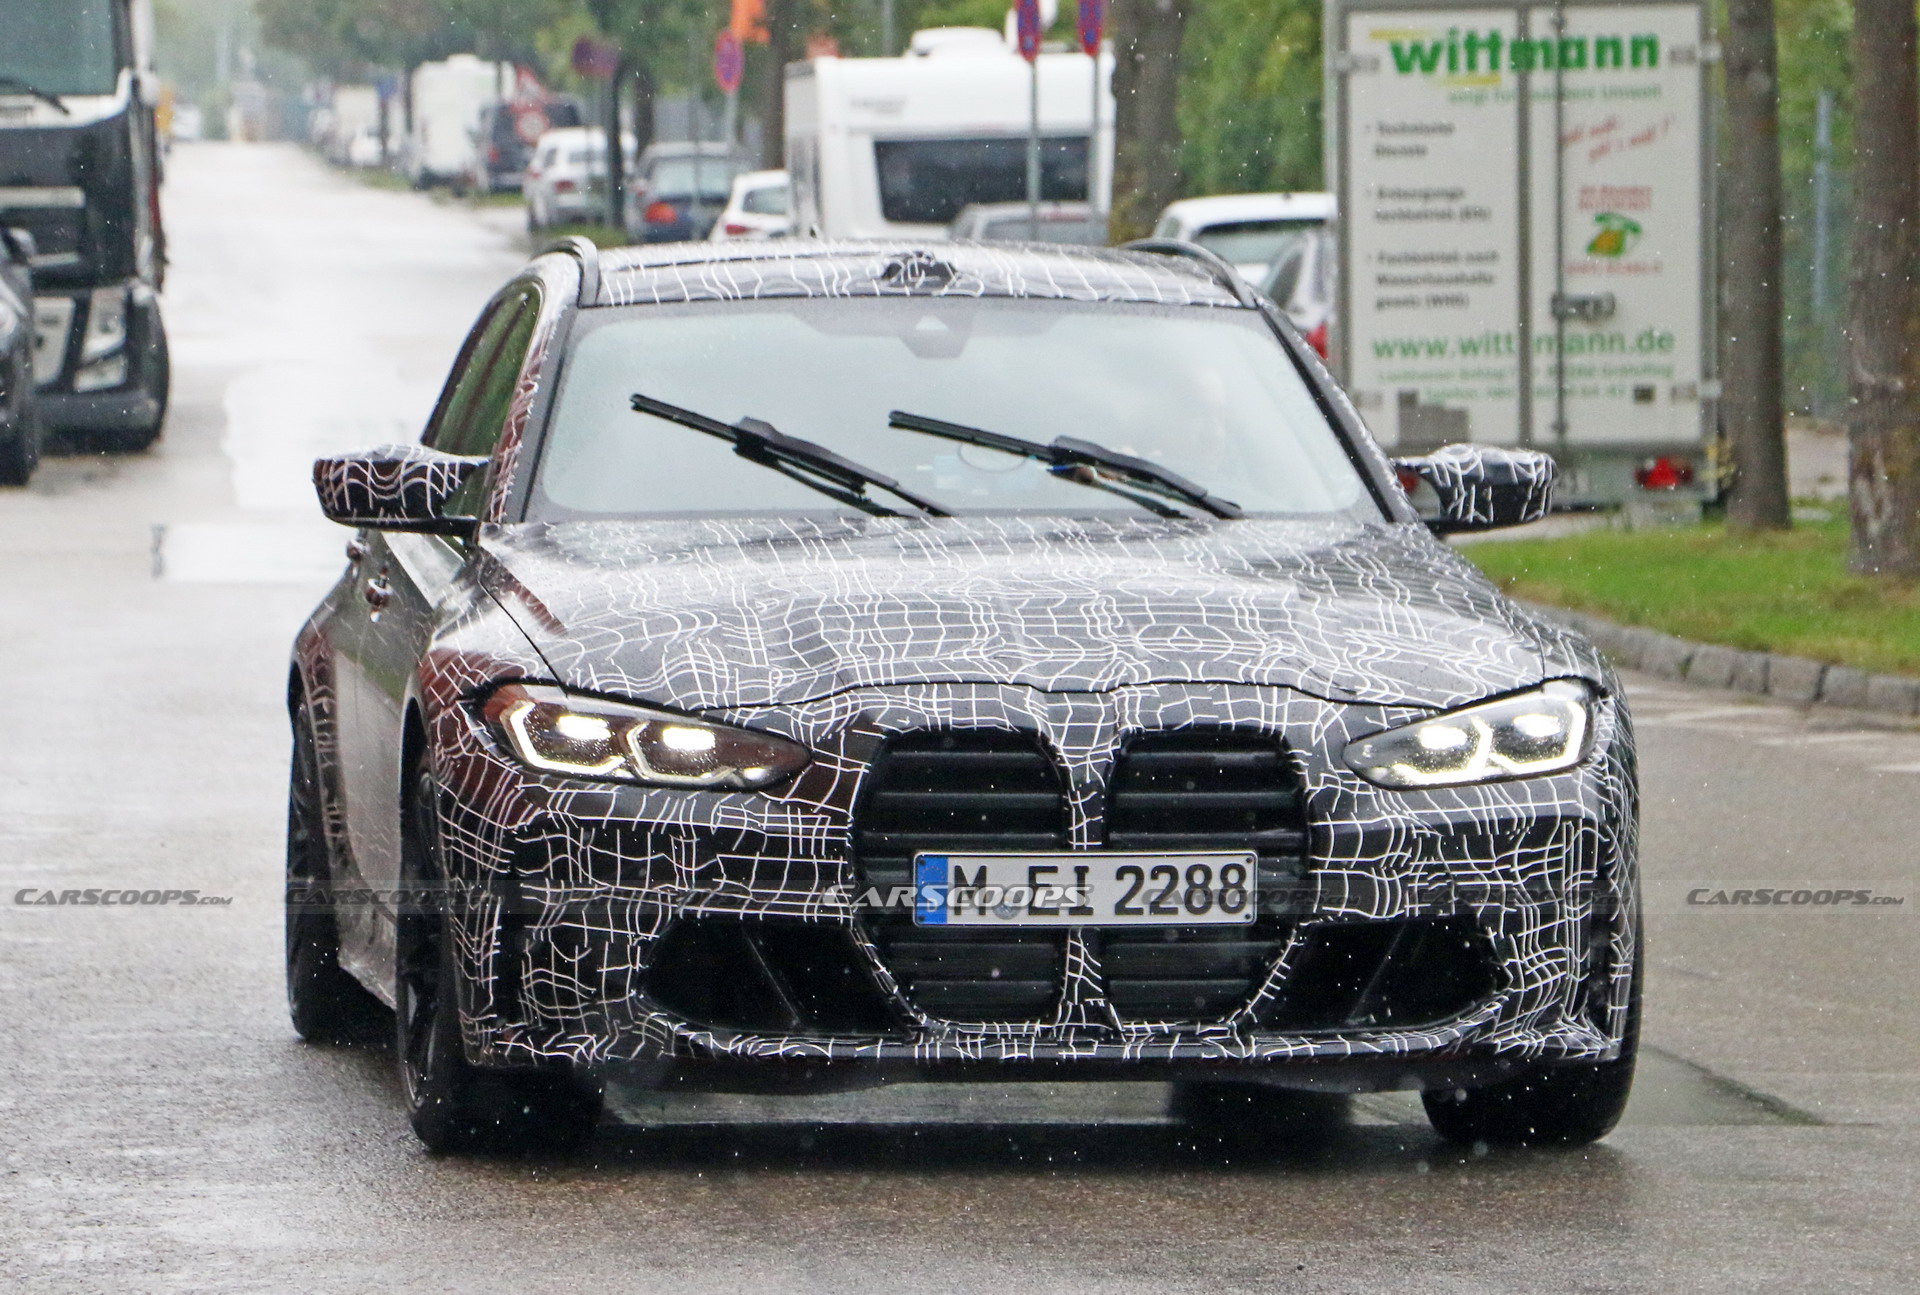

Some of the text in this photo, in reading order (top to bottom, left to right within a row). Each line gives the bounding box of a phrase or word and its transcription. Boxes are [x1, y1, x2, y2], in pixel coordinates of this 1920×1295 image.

[1391, 28, 1659, 74] wittmann
[1373, 329, 1675, 357] www.wittmann.de
[953, 863, 1249, 916] M EI 2288
